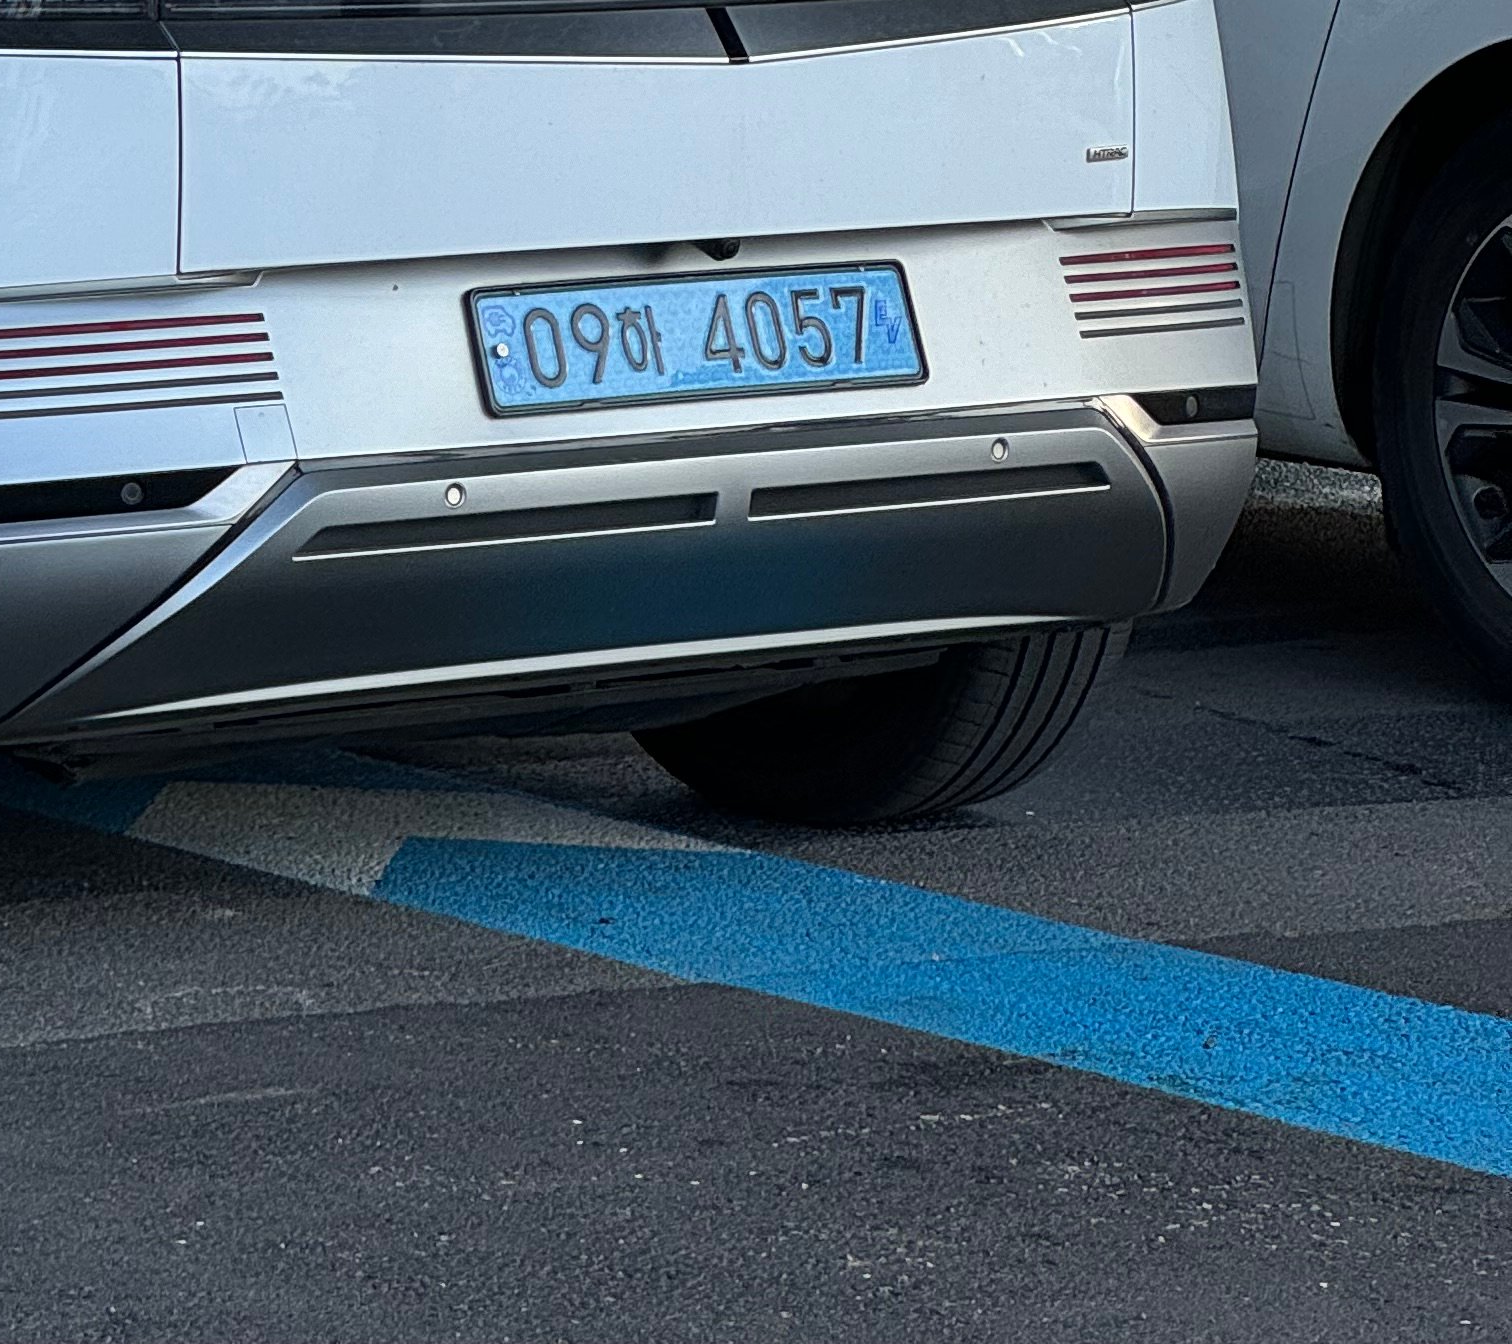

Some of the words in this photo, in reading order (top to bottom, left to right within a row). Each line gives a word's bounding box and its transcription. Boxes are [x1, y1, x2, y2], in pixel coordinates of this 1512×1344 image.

[523, 302, 665, 389] 09하
[704, 286, 866, 373] 4057
[875, 299, 902, 344] EV
